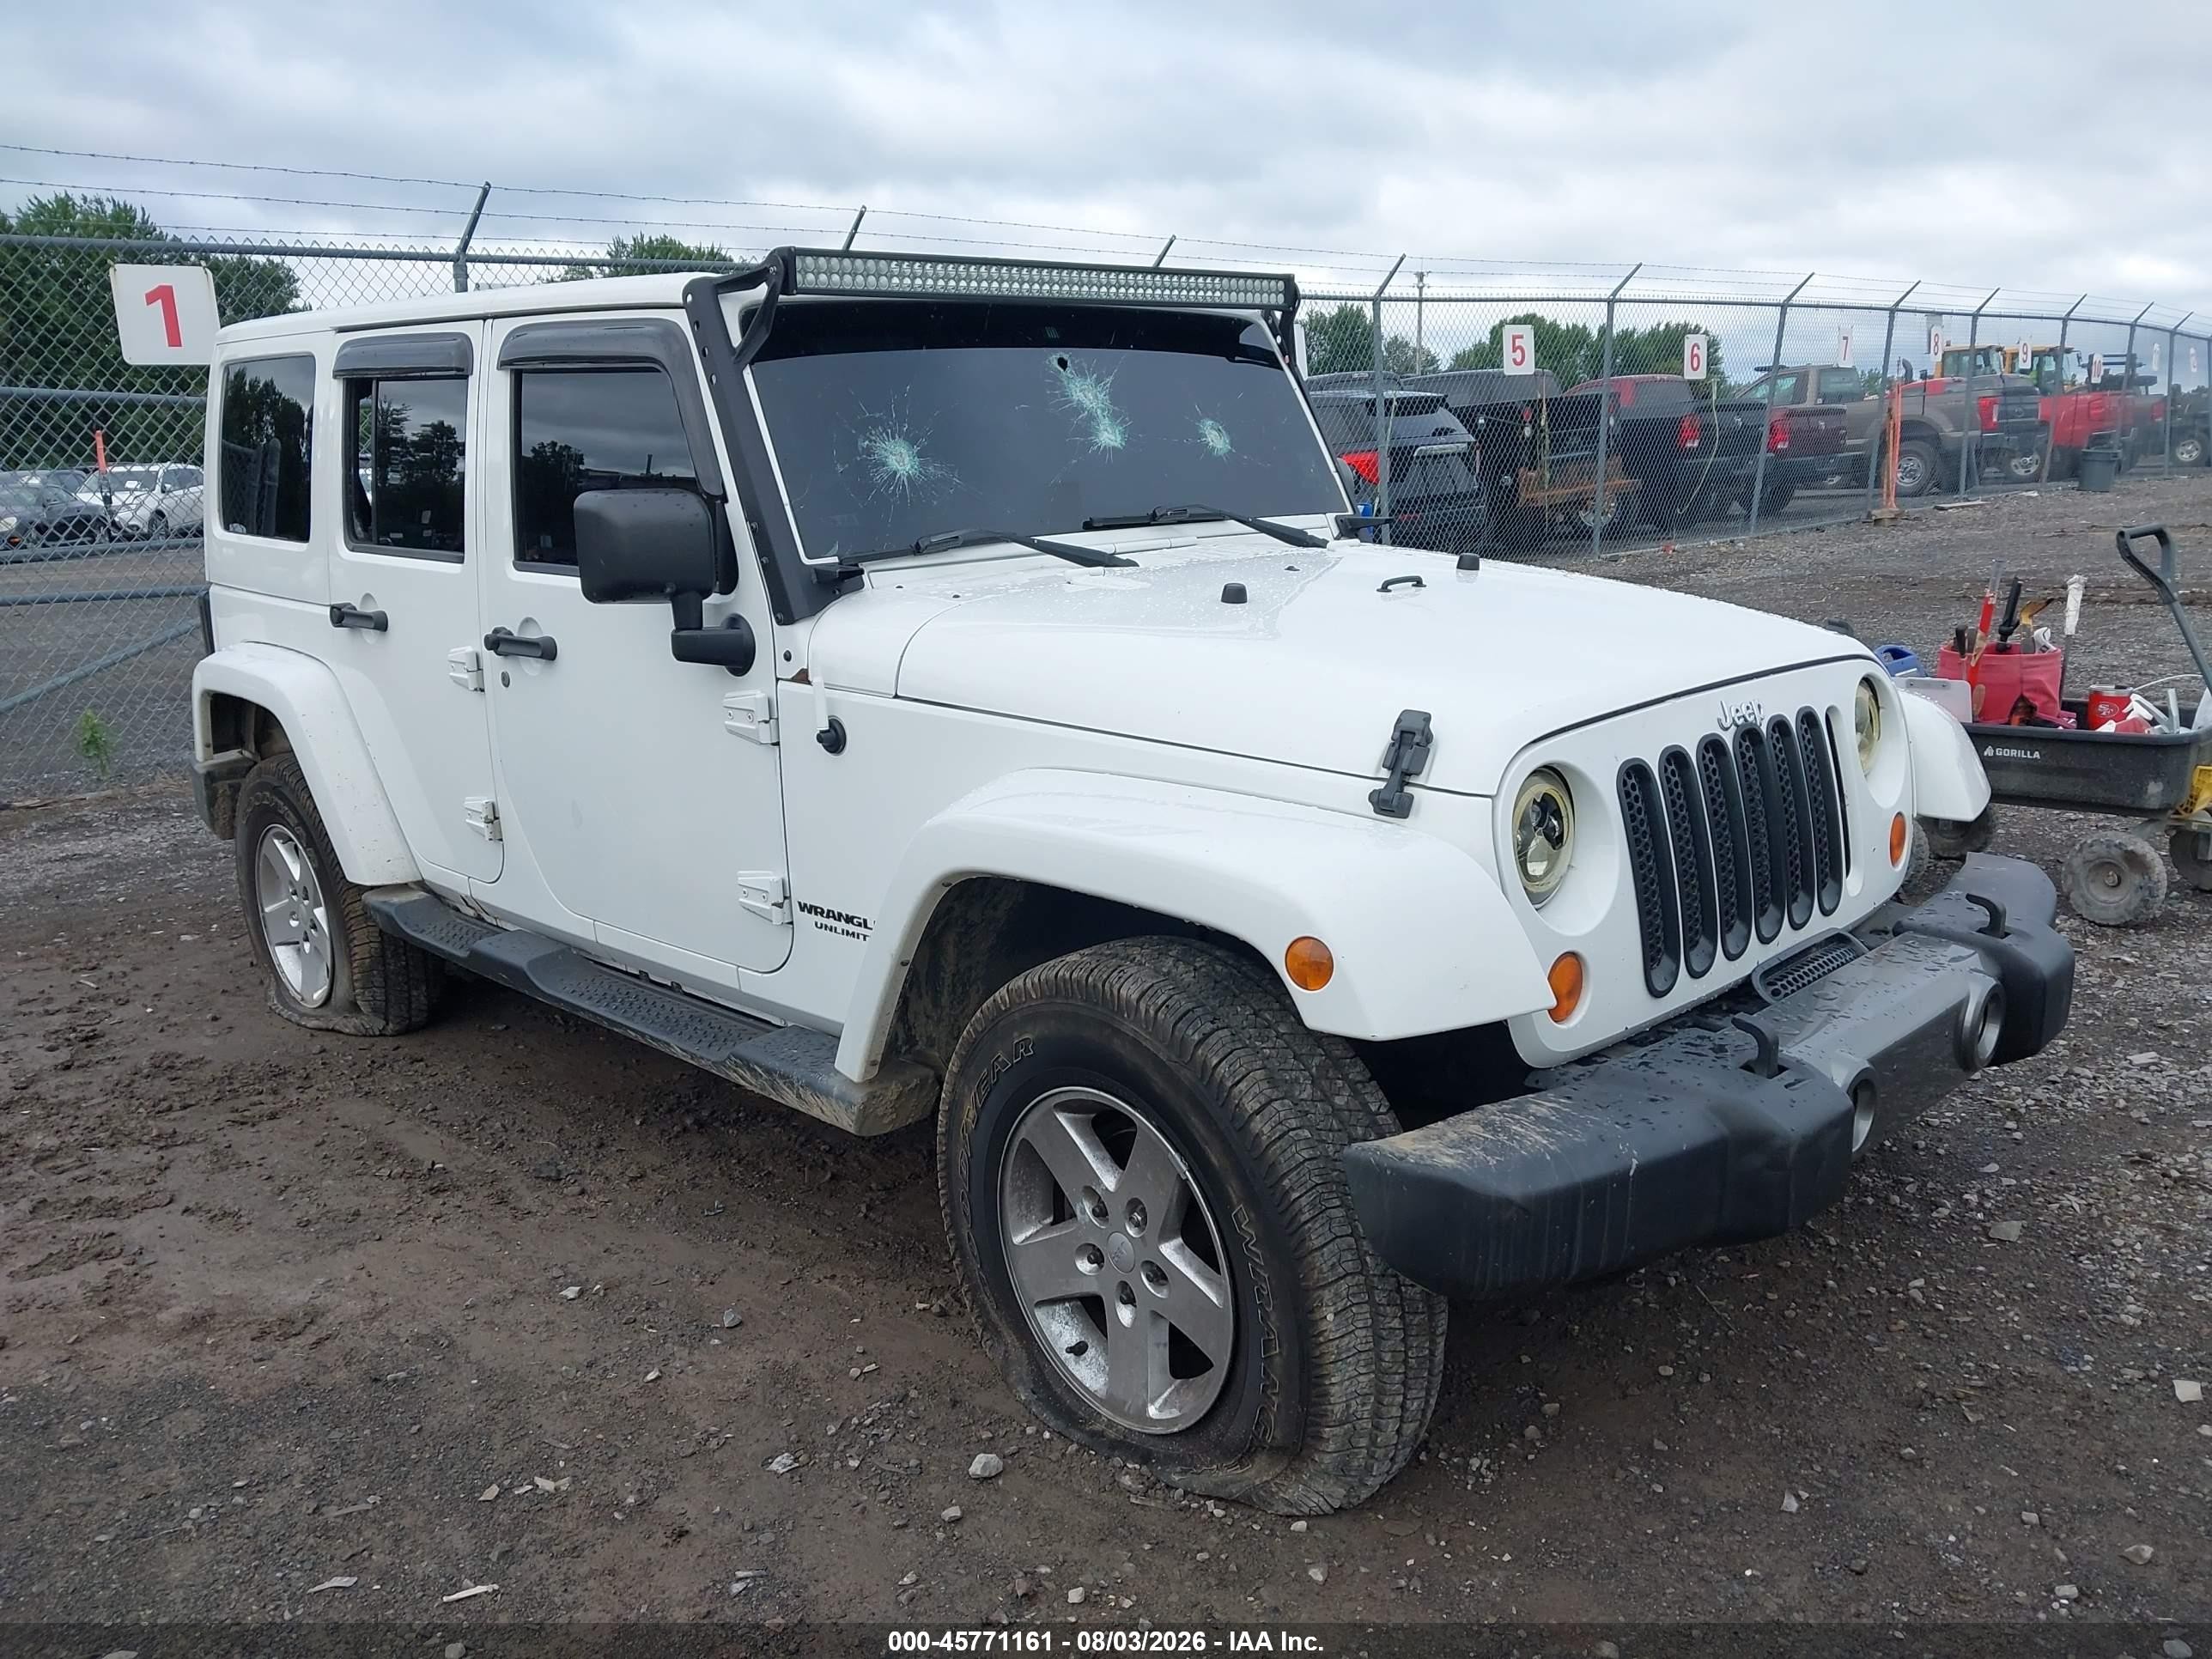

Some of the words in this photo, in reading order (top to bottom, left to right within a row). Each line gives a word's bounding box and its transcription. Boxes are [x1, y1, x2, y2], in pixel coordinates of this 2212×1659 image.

[144, 284, 183, 348] 1
[1511, 334, 1526, 367] 5
[1690, 343, 1701, 372] 6
[1842, 336, 1849, 362] 7
[1933, 333, 1940, 356] 8
[2022, 343, 2028, 363] 9
[2093, 359, 2102, 379] 10
[1717, 699, 1765, 732] Jeep
[1995, 747, 2041, 759] GORILLA
[798, 900, 876, 930] WRANGL
[814, 921, 871, 942] UNLIMIT
